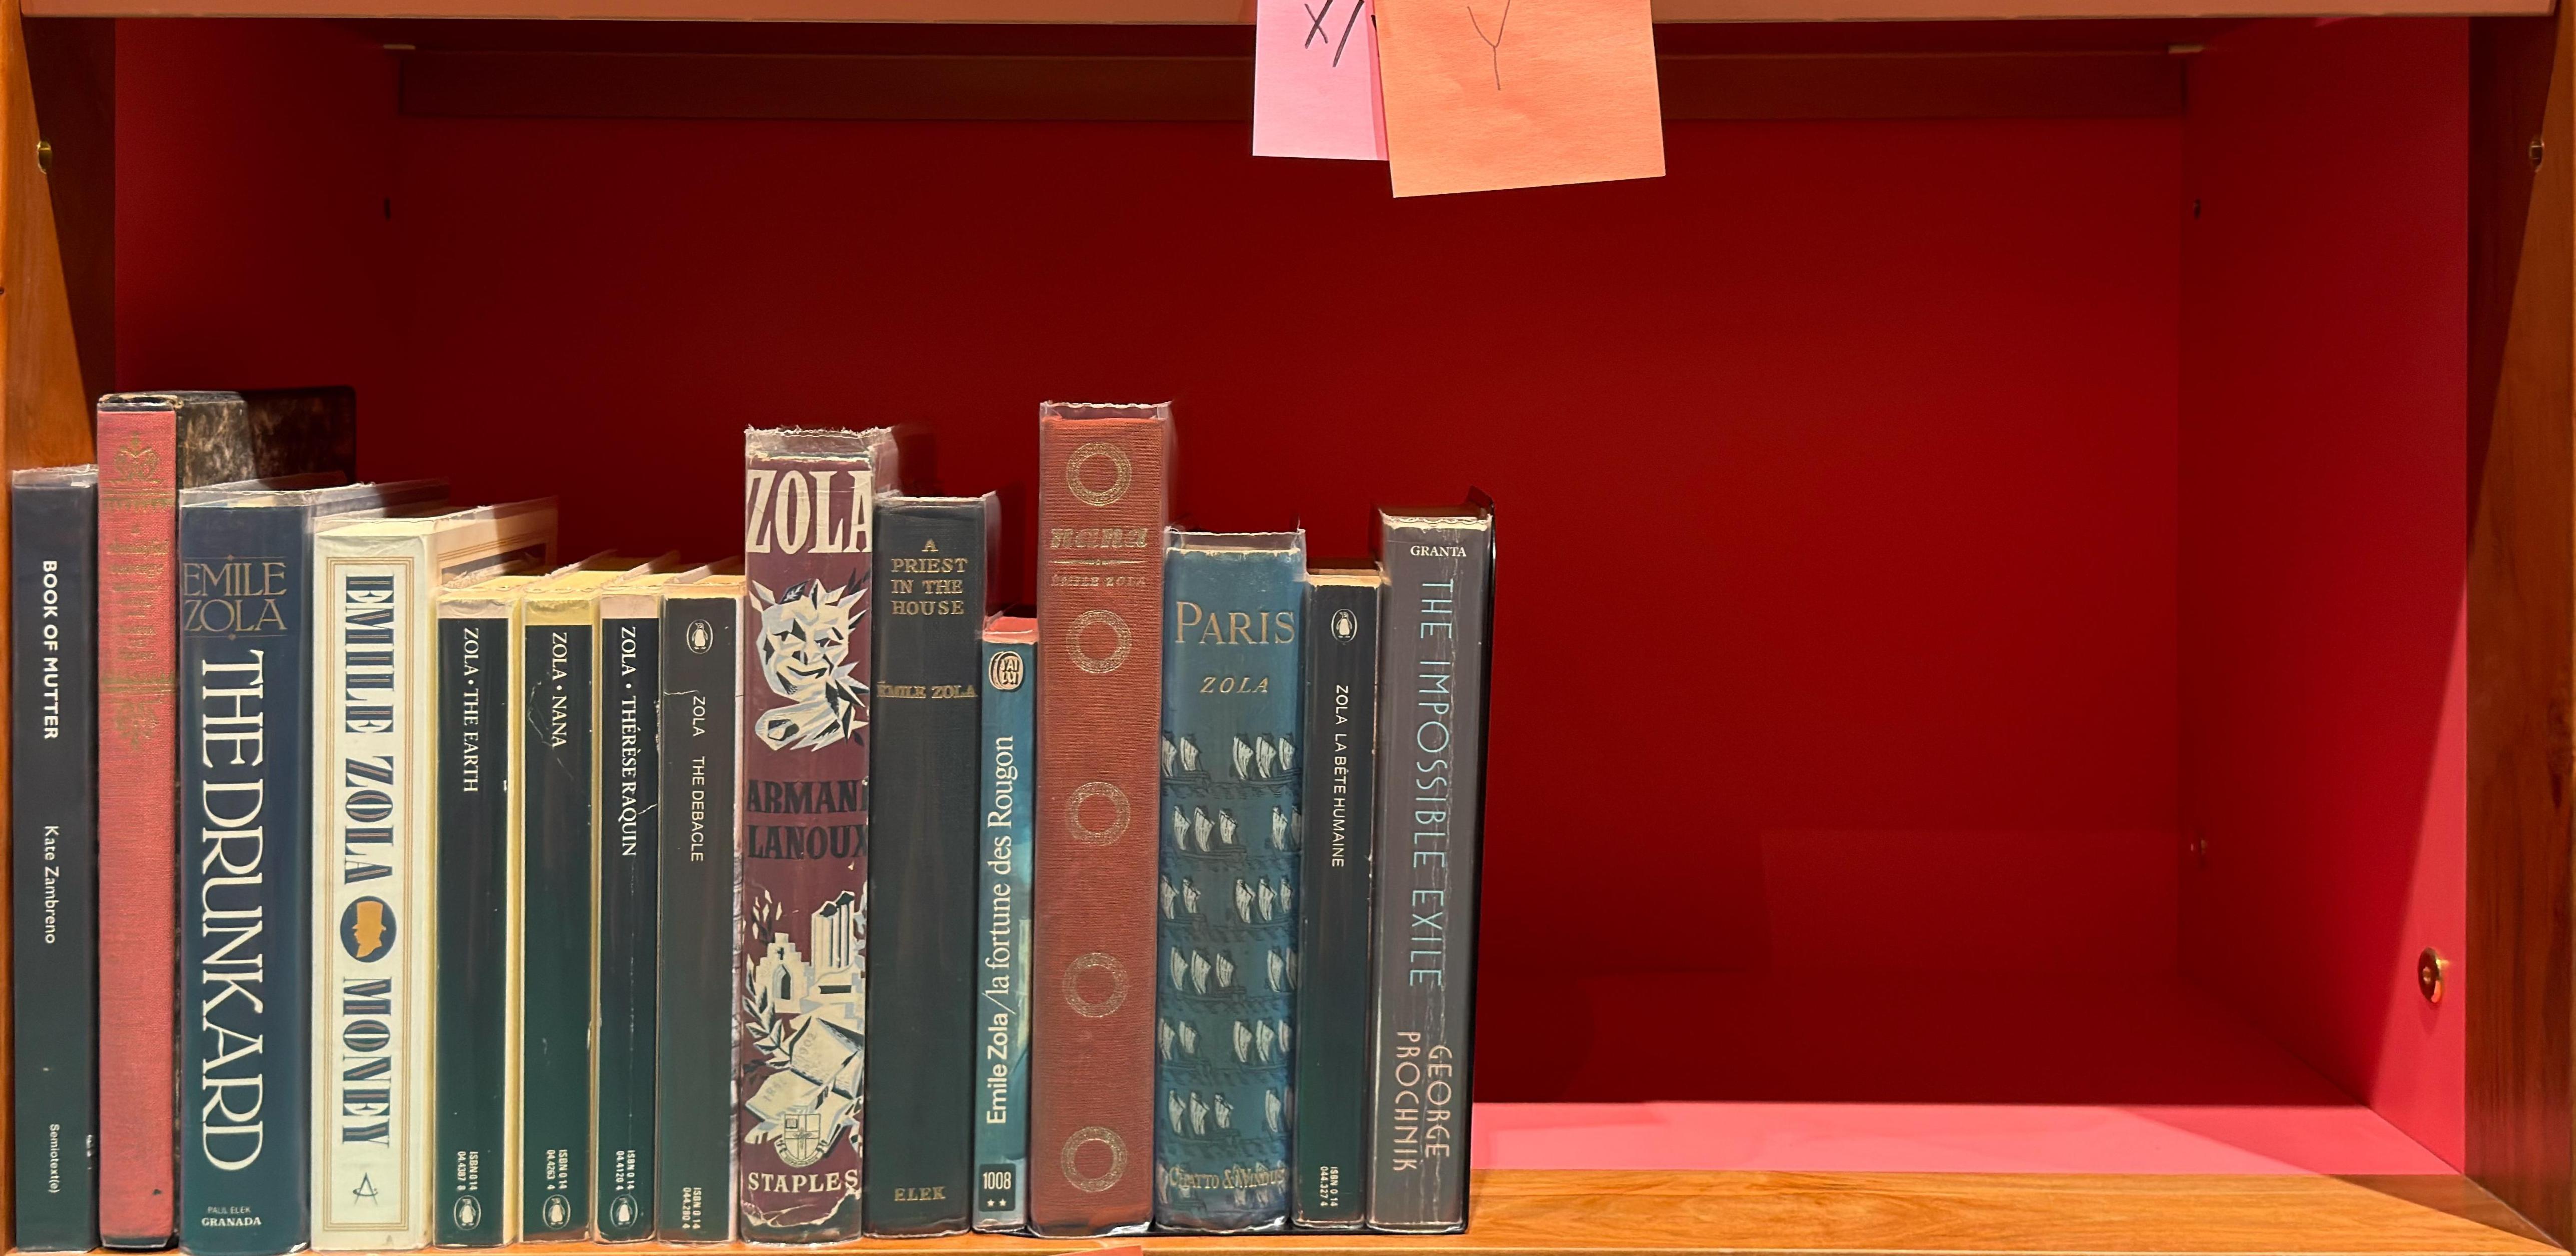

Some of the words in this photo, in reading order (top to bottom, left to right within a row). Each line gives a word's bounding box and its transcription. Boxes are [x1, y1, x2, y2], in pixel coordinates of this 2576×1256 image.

[746, 470, 872, 554] ZOLA
[922, 538, 938, 552] A
[1410, 545, 1467, 557] GRANTA
[183, 563, 287, 596] EMILE
[891, 558, 968, 573] PRIEST
[43, 561, 57, 617] BOOK
[891, 580, 914, 594] IN
[922, 580, 963, 594] THE
[184, 600, 287, 631] ZOLA
[891, 600, 965, 615] HOUSE
[1420, 578, 1454, 639] THE
[43, 625, 58, 650] OF
[345, 575, 395, 734] EMILE
[464, 627, 479, 676] ZOLA
[552, 632, 567, 681] ZOLA
[621, 627, 636, 676] ZOLA
[44, 657, 59, 739] MUTTER
[931, 685, 977, 698] ZOLA
[1001, 671, 1019, 685] LU
[1200, 676, 1269, 694] ZOLA
[202, 650, 264, 768] THE
[464, 688, 480, 726] THE
[552, 696, 567, 748] NANA
[692, 696, 705, 736] ZOLA
[1336, 685, 1349, 725] ZOLA
[621, 696, 641, 777] THÉRÈSE
[1335, 734, 1347, 752] LA
[463, 730, 478, 793] EARTH
[692, 757, 705, 786] THE
[988, 735, 1018, 828] Rougon
[1333, 757, 1349, 793] BÊTE
[1413, 661, 1451, 868] IMPOSSIBLE
[345, 756, 394, 884] ZOLA
[618, 781, 637, 856] RAQUIN
[691, 790, 704, 862] DEBACLE
[1331, 799, 1347, 867] HUMAINE
[44, 826, 59, 861] Kate
[987, 835, 1012, 875] des
[45, 867, 60, 944] Zambreno
[985, 883, 1011, 970] fortune
[1410, 890, 1444, 986] EXILE
[201, 779, 264, 1171] DRUNKARD
[342, 977, 392, 1148] MONEY
[987, 1064, 1007, 1124] Emile
[1393, 1031, 1422, 1171] PROCHNIK
[1425, 1045, 1452, 1158] GEORGE
[48, 1124, 61, 1193] Semiotext(e)
[469, 1151, 478, 1173] ISBN
[559, 1149, 568, 1171] ISBN
[627, 1150, 635, 1170] ISBN
[1330, 1167, 1338, 1187] ISBN
[693, 1187, 702, 1208] ISBN
[748, 1168, 859, 1193] STAPLES
[894, 1186, 946, 1202] ELEK
[983, 1172, 1012, 1190] 1008
[202, 1217, 261, 1227] GRANADA
